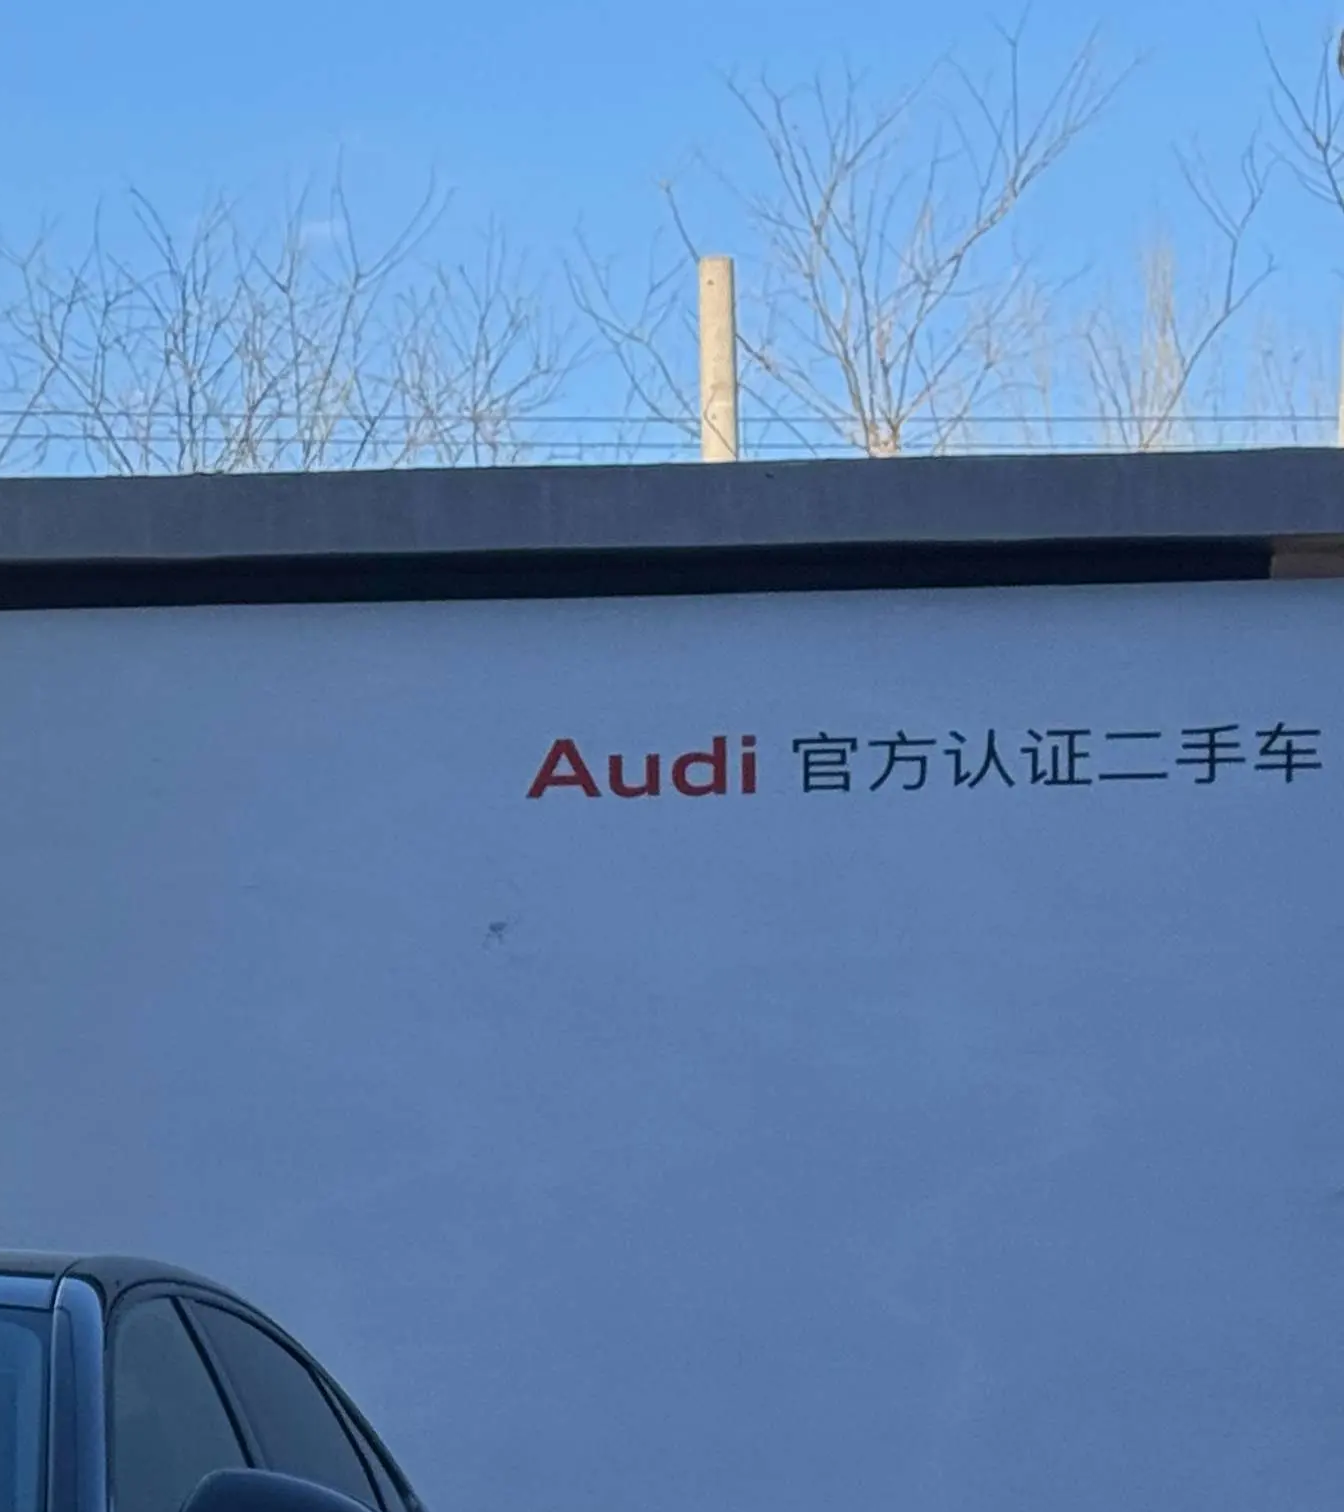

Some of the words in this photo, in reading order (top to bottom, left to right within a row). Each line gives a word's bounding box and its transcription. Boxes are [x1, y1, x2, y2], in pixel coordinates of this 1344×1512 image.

[526, 735, 758, 798] Audi
[791, 722, 1324, 794] 官方认证二手车
